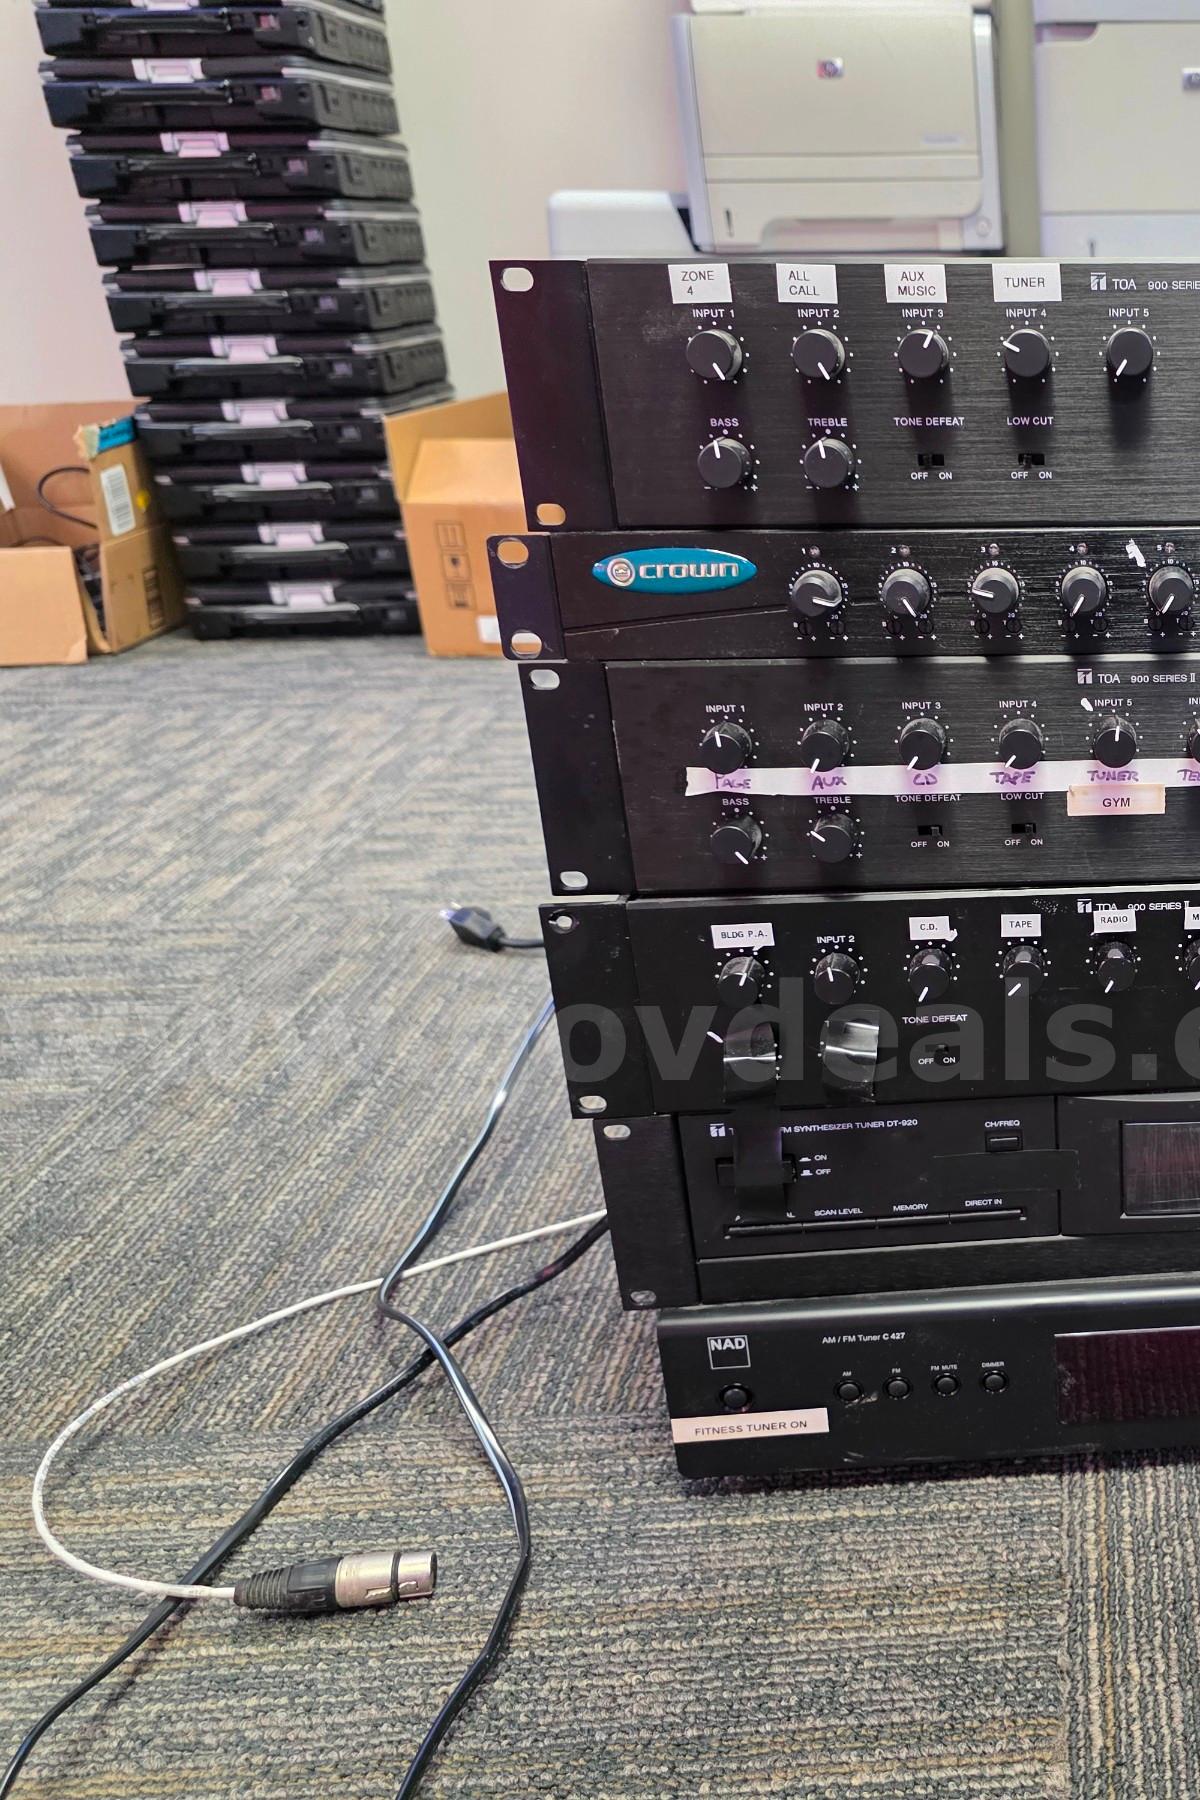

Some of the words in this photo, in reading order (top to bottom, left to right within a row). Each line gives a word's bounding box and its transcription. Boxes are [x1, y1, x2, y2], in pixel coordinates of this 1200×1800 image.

[681, 270, 715, 282] ZONE
[788, 270, 810, 282] ALL
[900, 271, 925, 282] AUX
[1004, 276, 1045, 289] TUNER
[1112, 278, 1137, 290] TOA
[1147, 280, 1168, 290] 900
[687, 285, 694, 296] 4
[789, 285, 820, 297] CALL
[897, 285, 936, 296] MUSIC
[692, 308, 725, 319] INPUT
[729, 308, 735, 319] 1
[902, 308, 933, 318] INPUT
[936, 308, 944, 318] 3
[1005, 308, 1037, 318] INPUT
[1039, 308, 1047, 318] 4
[710, 417, 739, 428] BASS
[807, 417, 848, 428] TREBLE
[893, 417, 923, 427] TONE
[925, 417, 965, 427] DEFEAT
[1006, 416, 1030, 426] LOW
[1032, 416, 1054, 426] CUT
[910, 471, 929, 481] OFF
[938, 471, 952, 481] ON
[639, 562, 739, 579] crown
[1097, 673, 1120, 684] TOA
[1130, 674, 1150, 684] 900
[1152, 673, 1188, 683] SERIES
[1094, 698, 1123, 708] INPUT
[1126, 698, 1133, 707] 5
[811, 773, 847, 791] AUX
[912, 773, 938, 786] CD
[989, 770, 1035, 785] TAPE
[1087, 769, 1139, 783] TUNER
[814, 796, 851, 805] TREBLE
[895, 794, 922, 803] TONE
[924, 793, 961, 802] DEFEAT
[1000, 792, 1022, 800] LOW
[1024, 792, 1044, 800] CUT
[722, 798, 750, 806] BASS
[1102, 797, 1131, 808] GYM
[1148, 901, 1183, 911] SERIES
[1009, 920, 1033, 929] TAPE
[1100, 915, 1128, 925] RADIO
[919, 923, 938, 932] C.D.
[720, 930, 744, 940] BLDG
[747, 929, 768, 939] P.A.
[816, 935, 847, 944] INPUT
[848, 935, 855, 943] 2
[902, 1015, 929, 1024] TONE
[931, 1014, 968, 1023] DEFEAT
[793, 1122, 853, 1133] SYNTHESIZER
[855, 1121, 885, 1130] TUNER
[887, 1119, 918, 1128] DT-920
[984, 1120, 1020, 1128] CH/FREQ
[892, 1203, 929, 1212] MEMORY
[965, 1199, 993, 1207] DIRECT
[994, 1198, 1002, 1206] IN
[814, 1209, 836, 1217] SCAN
[838, 1207, 863, 1216] LEVEL
[822, 1336, 836, 1344] AM
[842, 1335, 856, 1344] FM
[858, 1333, 881, 1343] Tuner
[890, 1332, 906, 1341] 427
[710, 1337, 746, 1351] NAD
[694, 1425, 744, 1436] FITNESS
[746, 1421, 787, 1432] TUNER
[790, 1420, 808, 1429] ON
